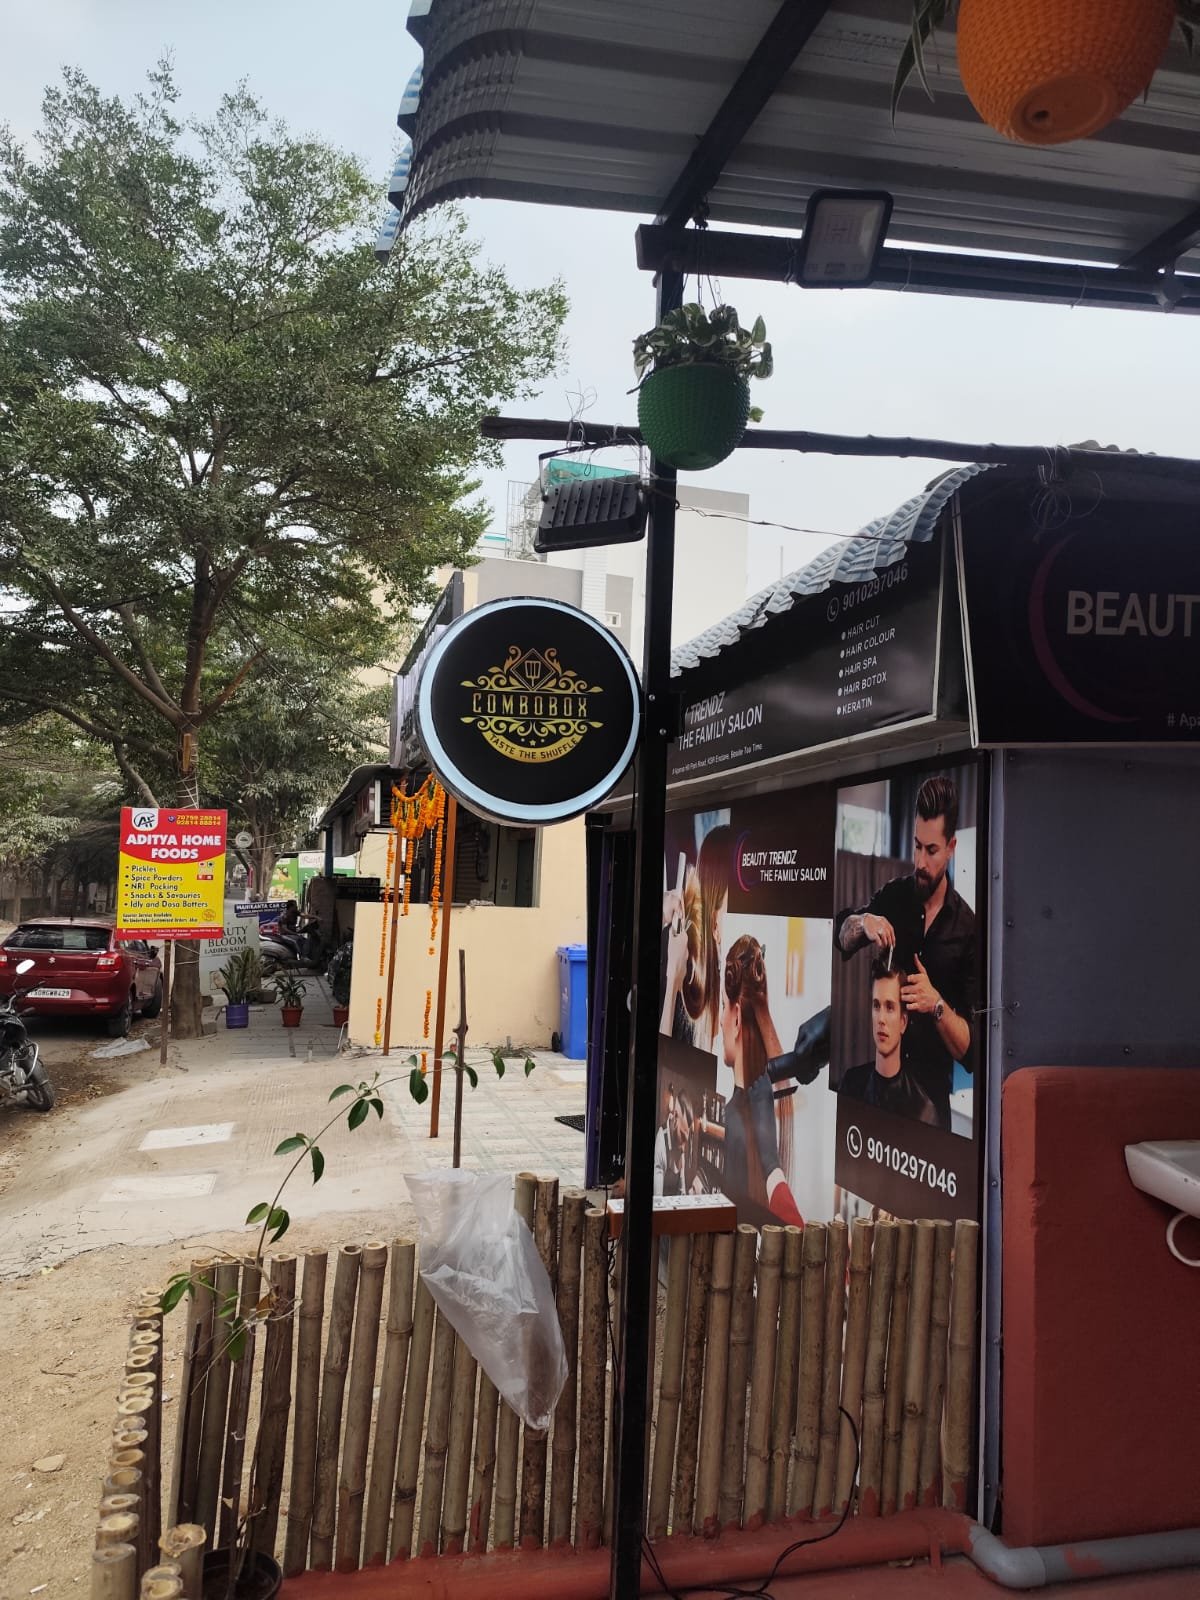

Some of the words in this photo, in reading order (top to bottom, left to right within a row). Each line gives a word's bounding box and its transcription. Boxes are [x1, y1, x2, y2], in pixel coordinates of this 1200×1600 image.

[842, 562, 910, 611] 9010297046
[1066, 590, 1200, 637] BEAUT
[847, 623, 864, 640] HAIR
[865, 615, 881, 632] CUT
[845, 642, 863, 658] HAIR
[863, 627, 896, 651] COLOUR
[844, 661, 862, 677] HAIR
[862, 655, 878, 670] SPA
[843, 681, 860, 696] HAIR
[861, 671, 887, 690] BOTOX
[473, 692, 587, 717] COMBOBOX
[690, 691, 726, 725] TRENDZ
[842, 695, 873, 716] KERATIN
[678, 730, 694, 751] THE
[695, 718, 727, 745] FAMILY
[727, 703, 763, 734] SALON
[489, 733, 515, 755] TASTE
[519, 750, 537, 759] THE
[540, 738, 578, 759] SHUFFLE
[126, 834, 178, 845] ADITYA
[181, 835, 222, 846] HOME
[151, 848, 199, 859] FOODS
[742, 851, 768, 867] BEAUTY
[768, 849, 798, 865] TRENDZ
[150, 883, 178, 891] Packing
[760, 869, 774, 882] THE
[774, 868, 800, 882] FAMILY
[800, 867, 827, 881] SALON
[208, 936, 247, 948] BLOOM
[867, 1137, 957, 1197] 9010297046
